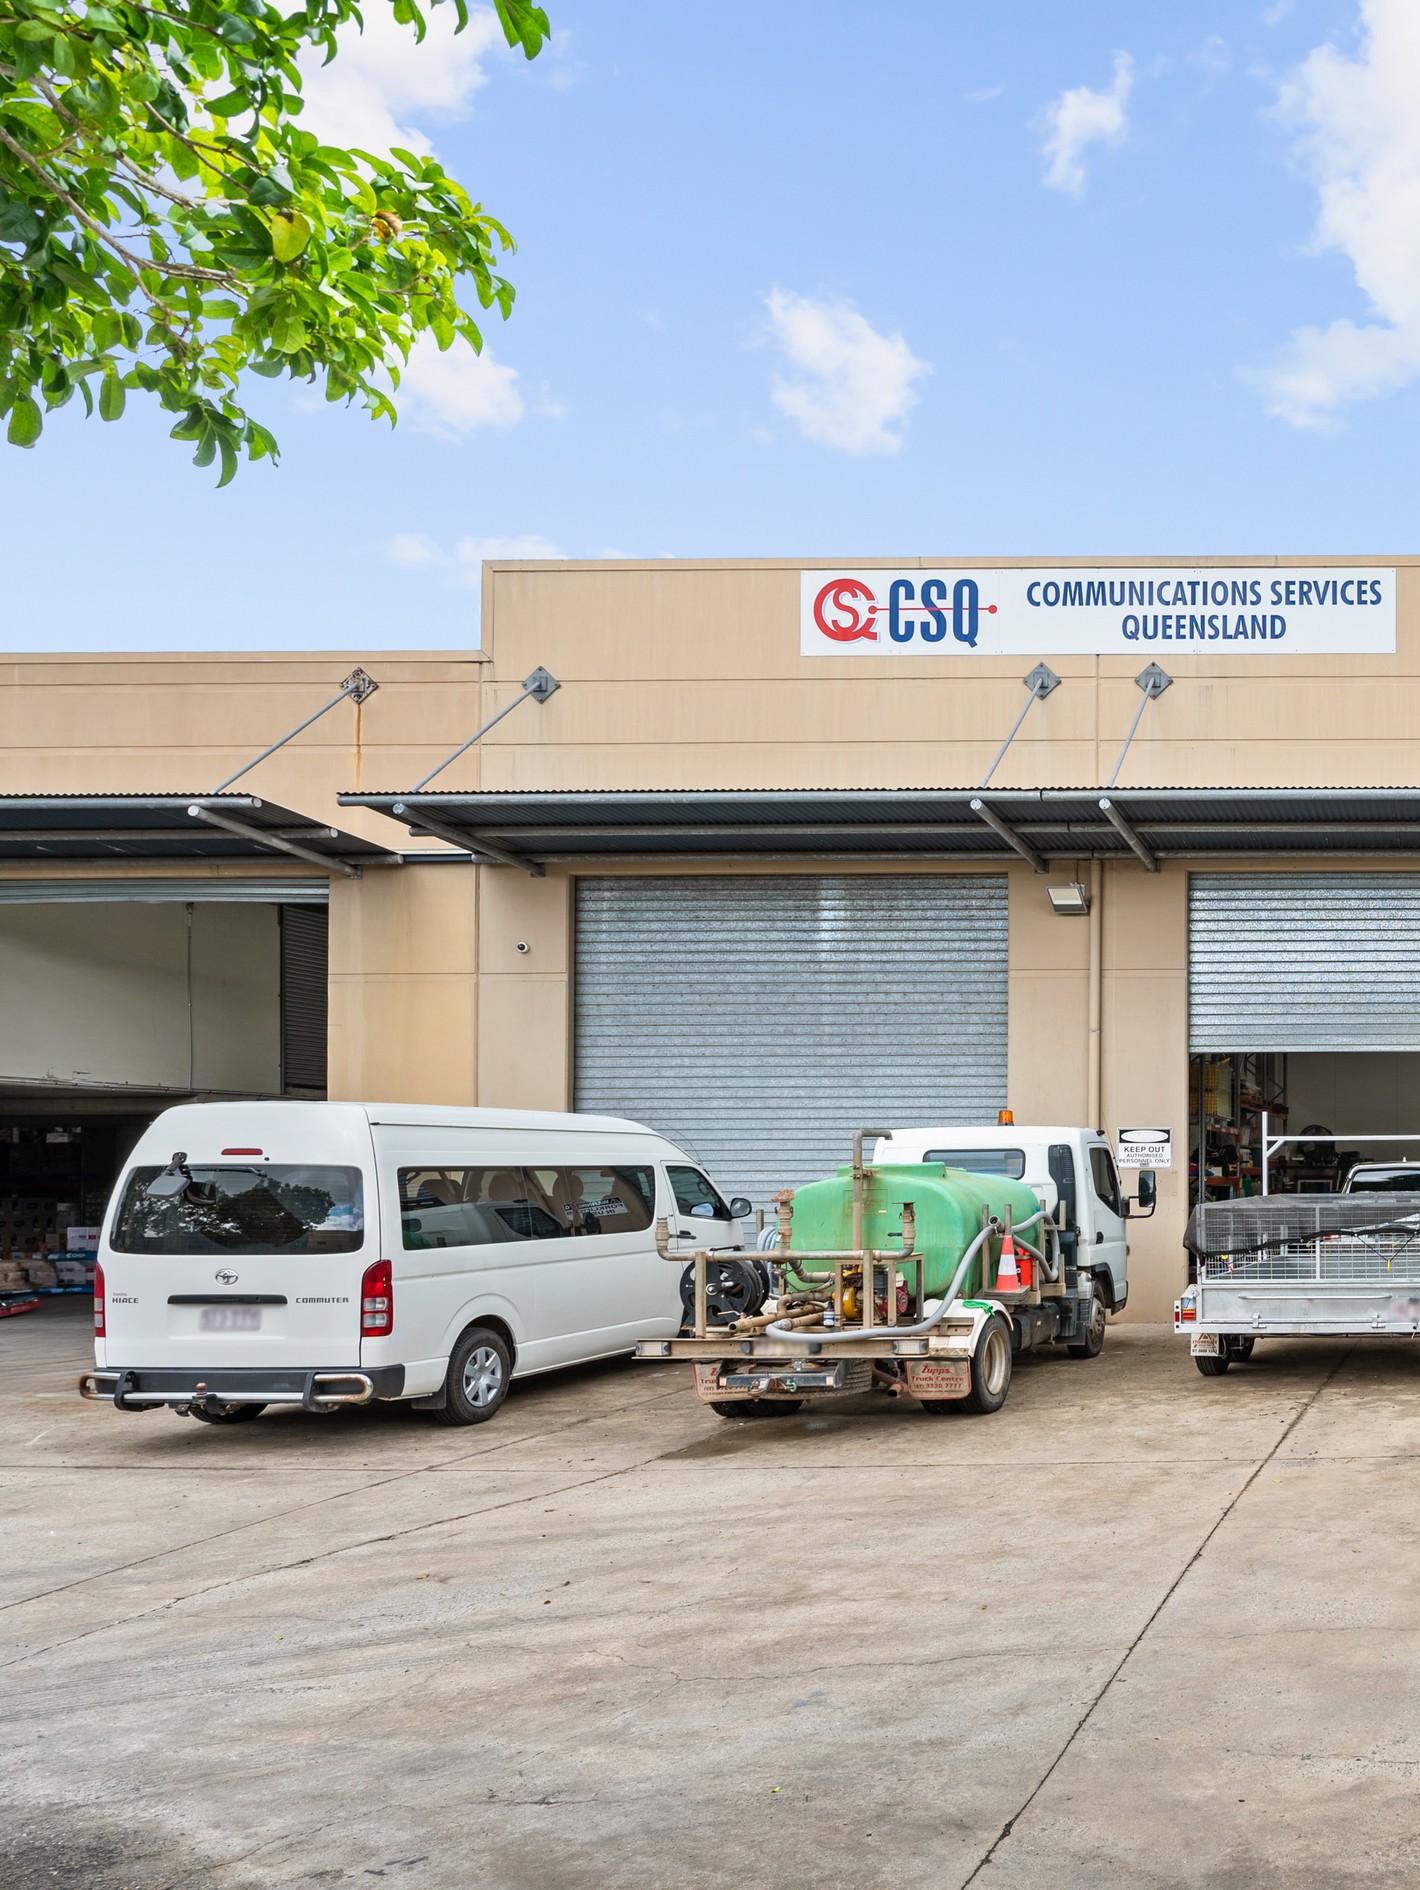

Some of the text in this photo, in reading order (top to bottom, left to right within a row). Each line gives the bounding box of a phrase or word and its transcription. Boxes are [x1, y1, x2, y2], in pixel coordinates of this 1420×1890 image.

[1026, 580, 1382, 607] COMMUNICATIONS SERVICES
[889, 579, 978, 648] CSQ
[1121, 614, 1287, 641] QUEENSLAND
